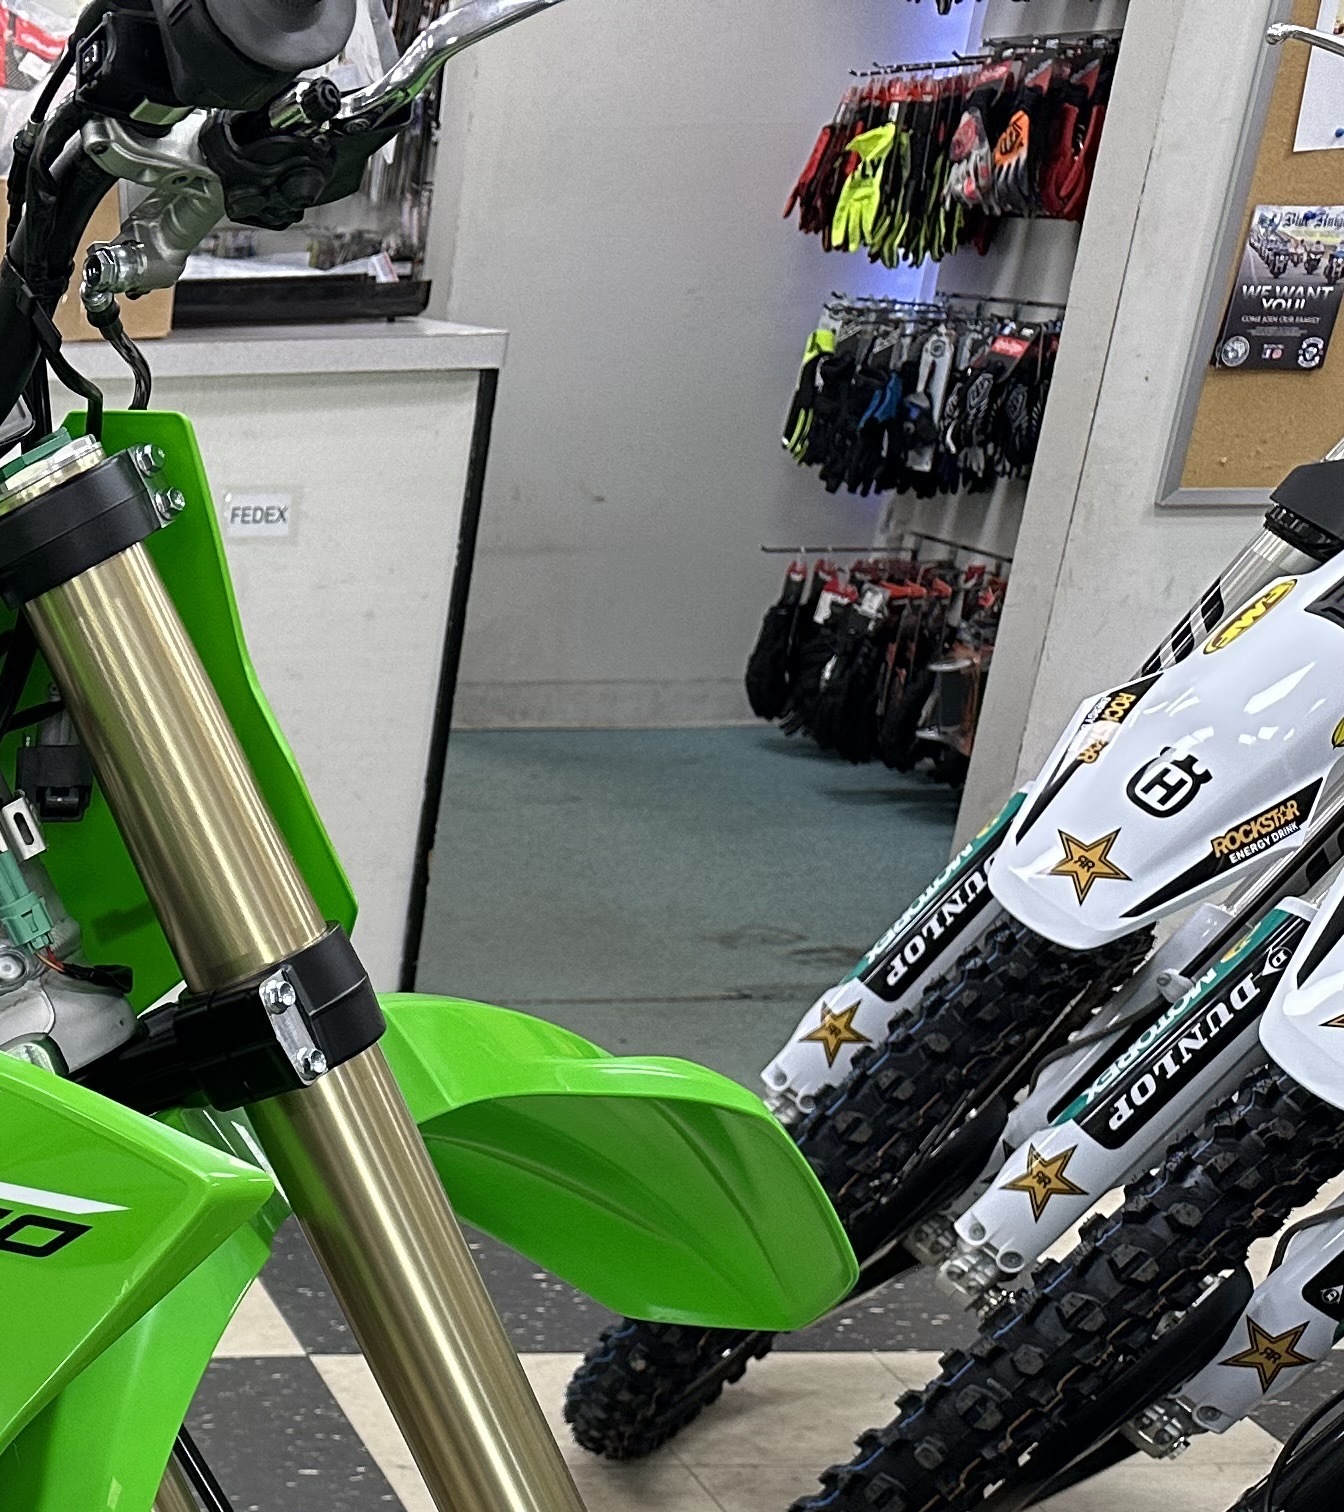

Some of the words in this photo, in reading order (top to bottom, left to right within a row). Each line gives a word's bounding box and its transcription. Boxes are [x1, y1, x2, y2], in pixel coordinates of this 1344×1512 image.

[1275, 286, 1334, 300] WANT
[230, 506, 288, 524] FEDEX
[1213, 801, 1300, 858] ROCKSTAR
[1230, 837, 1273, 864] ENERGY
[1272, 821, 1300, 842] DRINK
[1109, 973, 1261, 1131] DUNLOP
